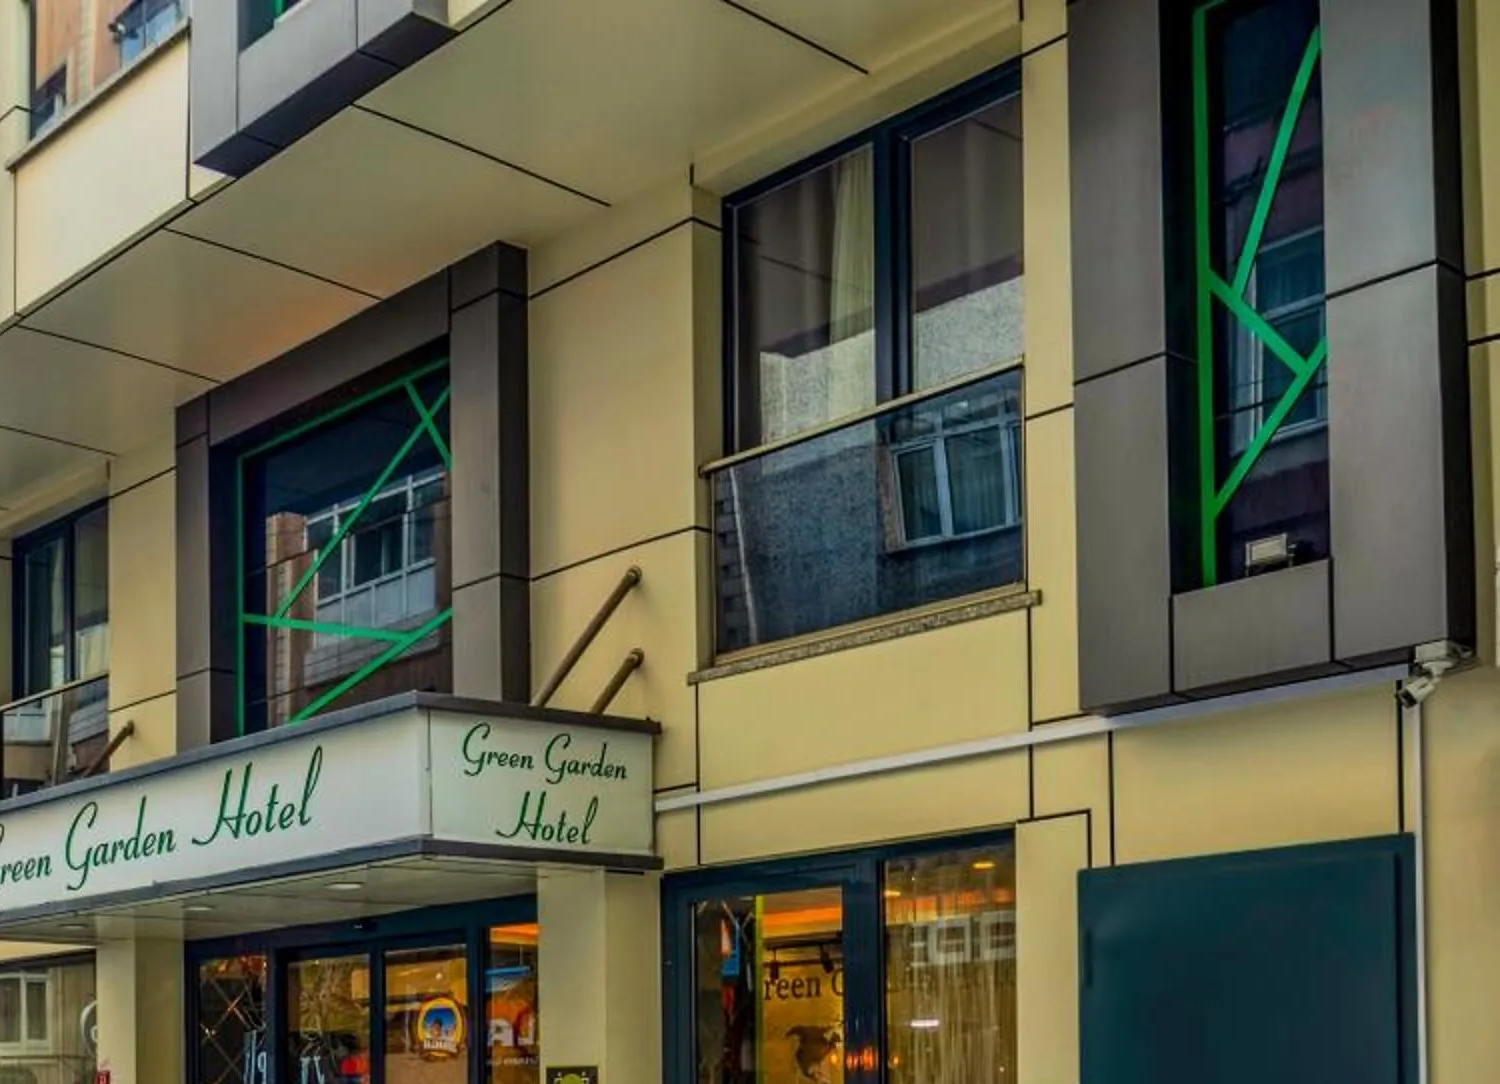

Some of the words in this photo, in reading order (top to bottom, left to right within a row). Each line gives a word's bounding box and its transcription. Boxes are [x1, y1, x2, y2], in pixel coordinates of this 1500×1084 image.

[462, 722, 534, 777] Green
[544, 733, 629, 785] Garden
[65, 797, 176, 891] Garden
[192, 746, 323, 847] Hotel
[496, 790, 599, 846] Hotel
[763, 976, 822, 1001] reen
